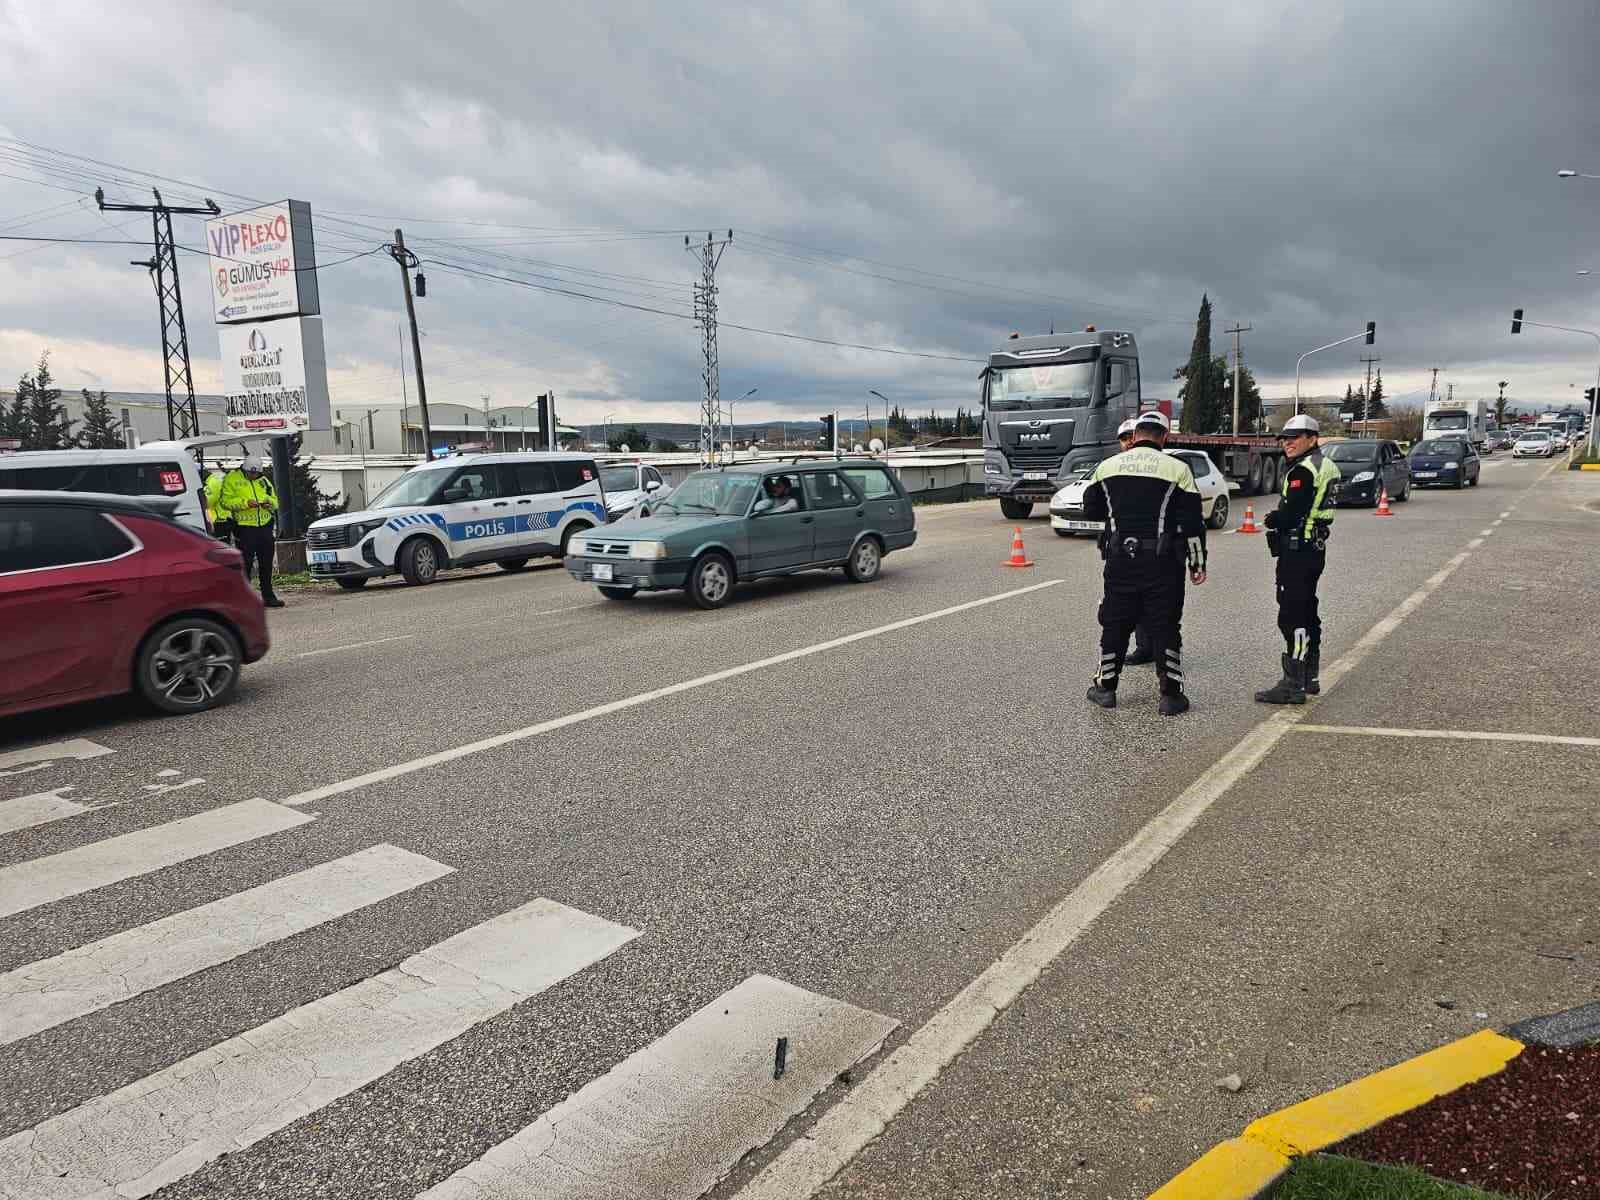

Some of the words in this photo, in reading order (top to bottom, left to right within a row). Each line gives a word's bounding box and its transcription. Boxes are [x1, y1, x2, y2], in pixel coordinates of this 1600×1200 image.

[1020, 433, 1051, 442] MAN
[163, 473, 181, 484] 112
[465, 519, 506, 538] POLİS
